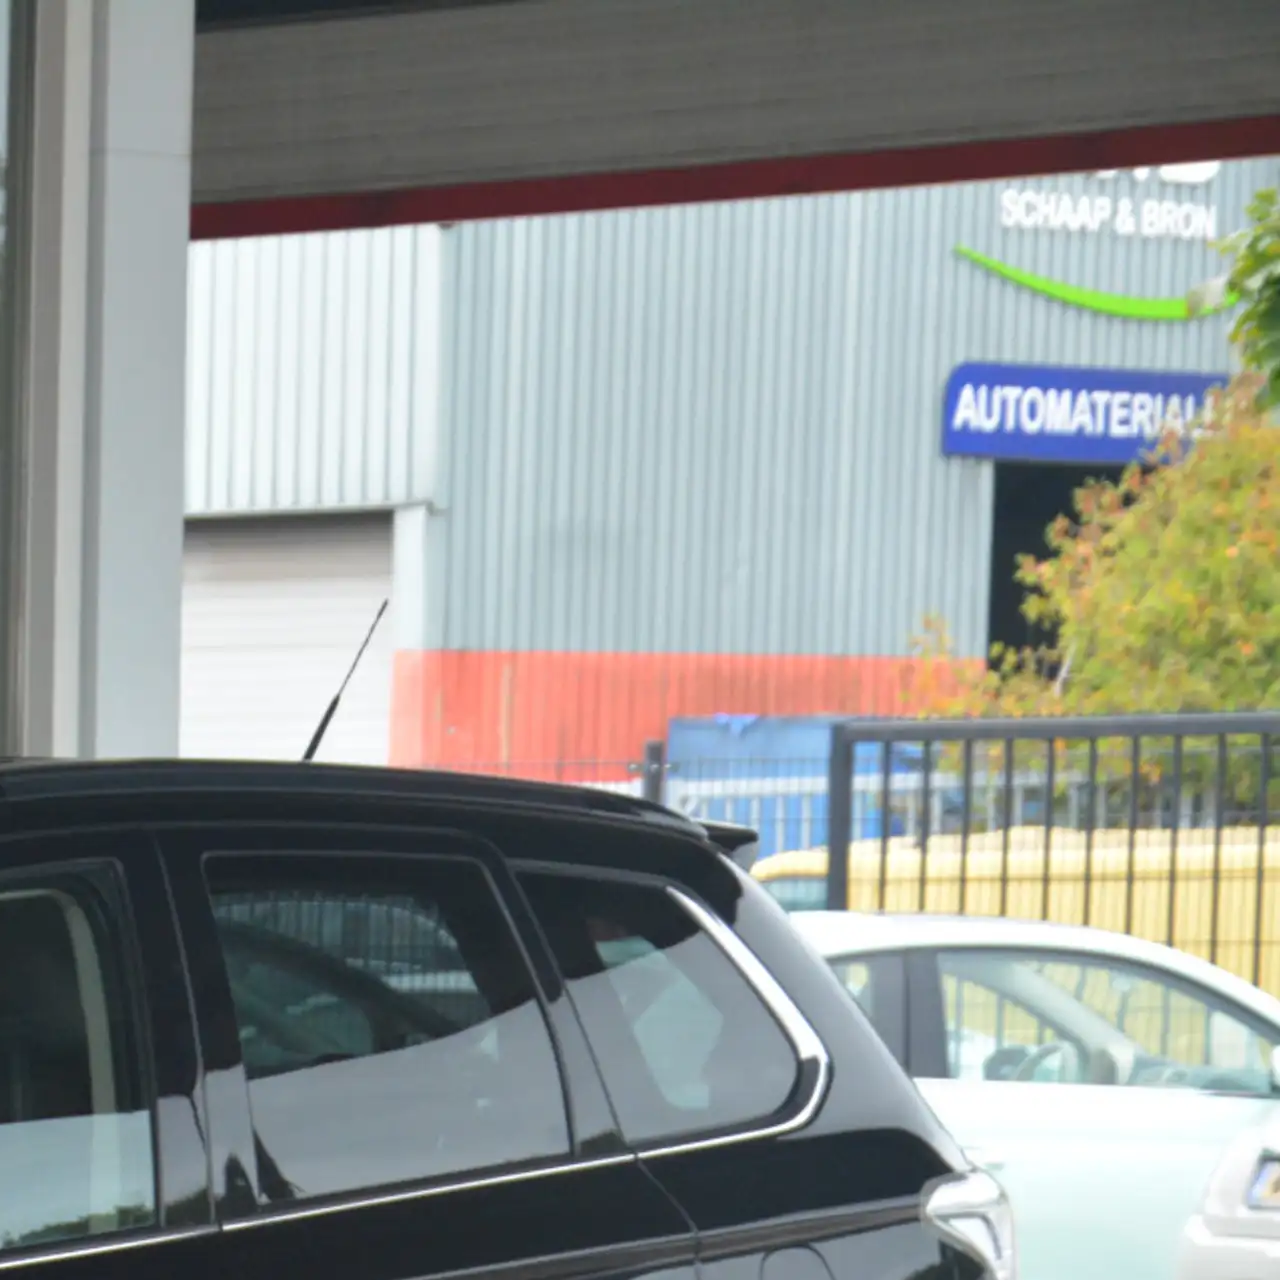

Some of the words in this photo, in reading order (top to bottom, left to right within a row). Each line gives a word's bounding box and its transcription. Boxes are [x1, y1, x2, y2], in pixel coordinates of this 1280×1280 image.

[1000, 188, 1111, 233] SCHAAP
[1114, 196, 1137, 236] &
[1140, 198, 1217, 241] BRON
[952, 383, 1218, 439] AUTOMATERIAL
